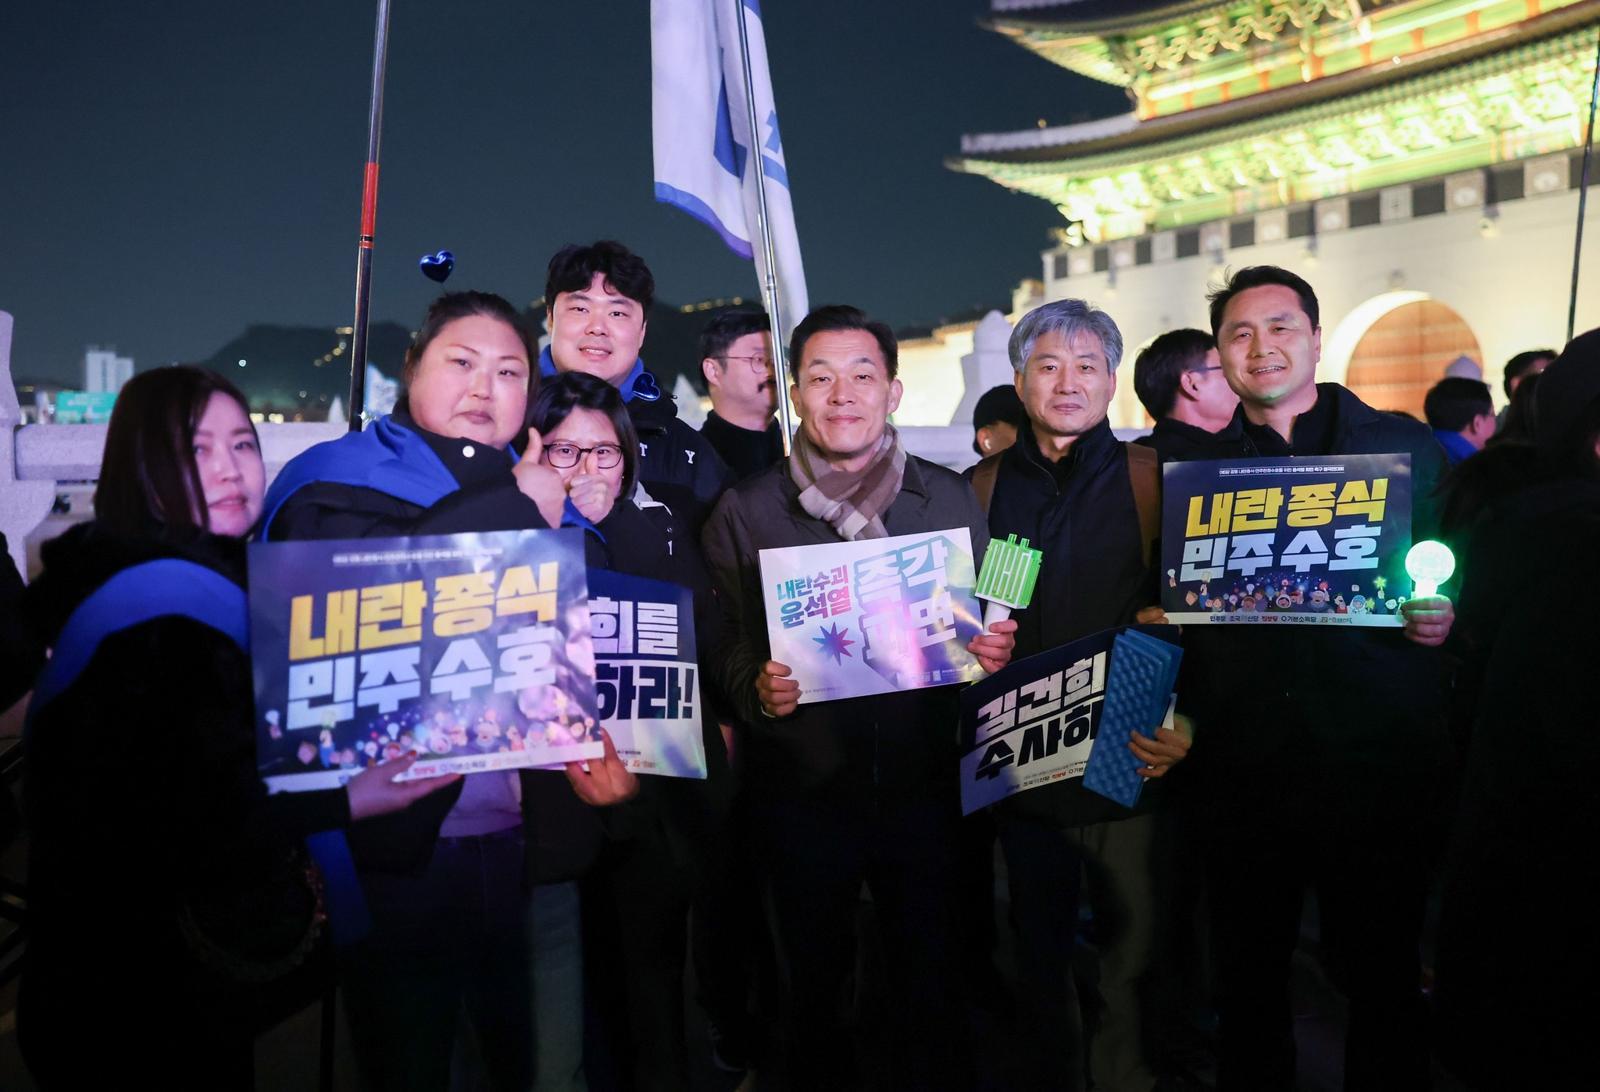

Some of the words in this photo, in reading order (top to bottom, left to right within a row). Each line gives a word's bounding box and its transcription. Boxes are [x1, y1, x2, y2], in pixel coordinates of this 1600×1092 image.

[1185, 487, 1284, 538] 내란
[1286, 478, 1389, 528] 종식
[776, 564, 849, 601] 내란수괴
[856, 538, 949, 604] 즉각
[1179, 532, 1276, 583] 민주
[1280, 524, 1382, 573] 수호
[288, 579, 427, 661] 내란
[432, 561, 559, 637] 종식
[780, 585, 852, 630] 윤석열
[286, 646, 421, 731] 민주
[429, 621, 558, 701] 수호
[595, 663, 695, 721] 하라!
[975, 650, 1107, 746] 김건희
